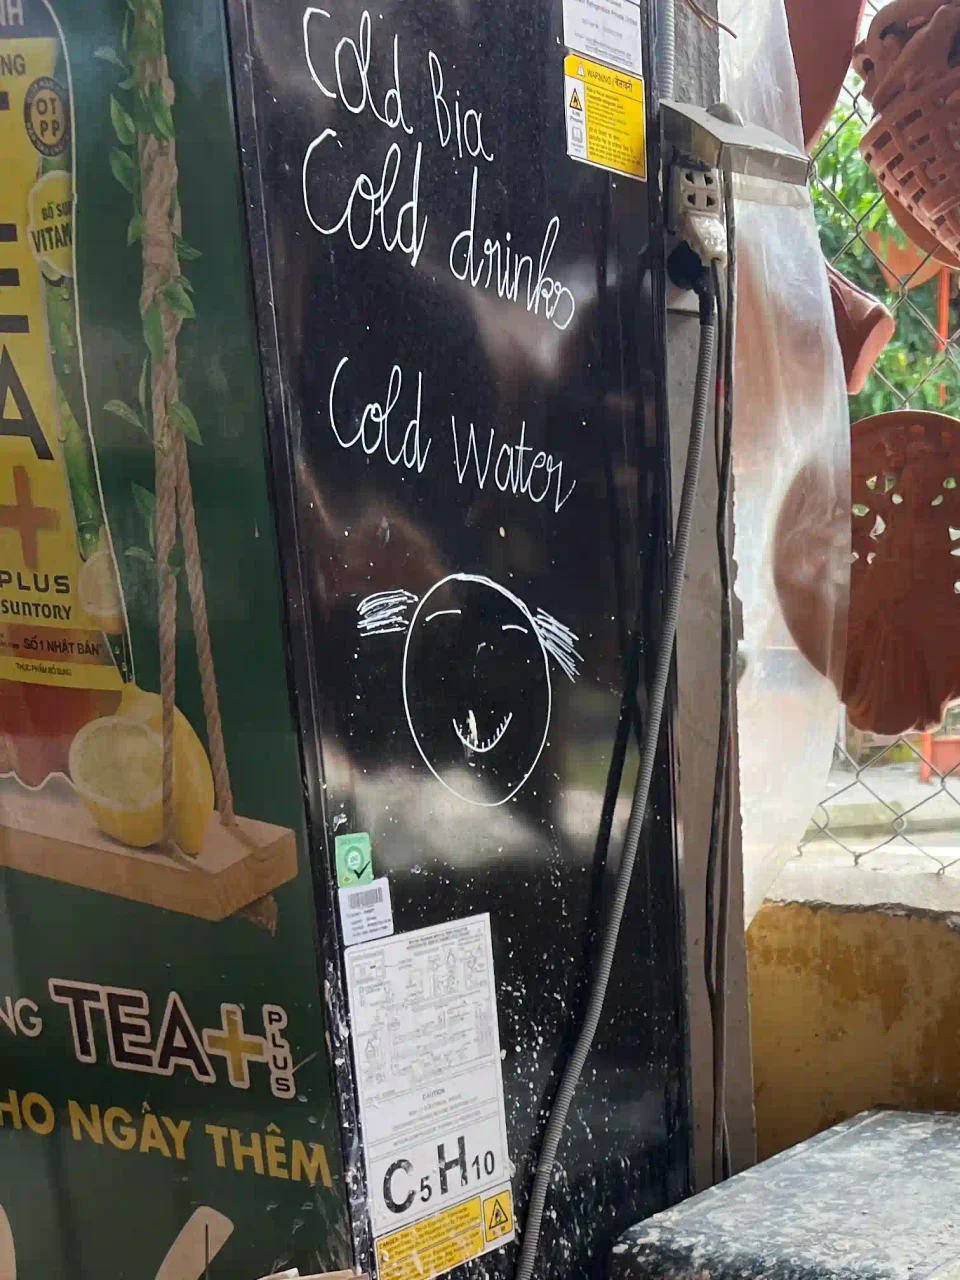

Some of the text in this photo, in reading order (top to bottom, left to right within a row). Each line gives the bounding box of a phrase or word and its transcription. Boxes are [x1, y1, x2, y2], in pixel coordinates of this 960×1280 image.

[304, 7, 413, 135] Cold
[429, 51, 494, 162] Bia
[303, 128, 575, 330] Cold drinks
[330, 356, 431, 473] Cold
[205, 1122, 333, 1188] THÊM
